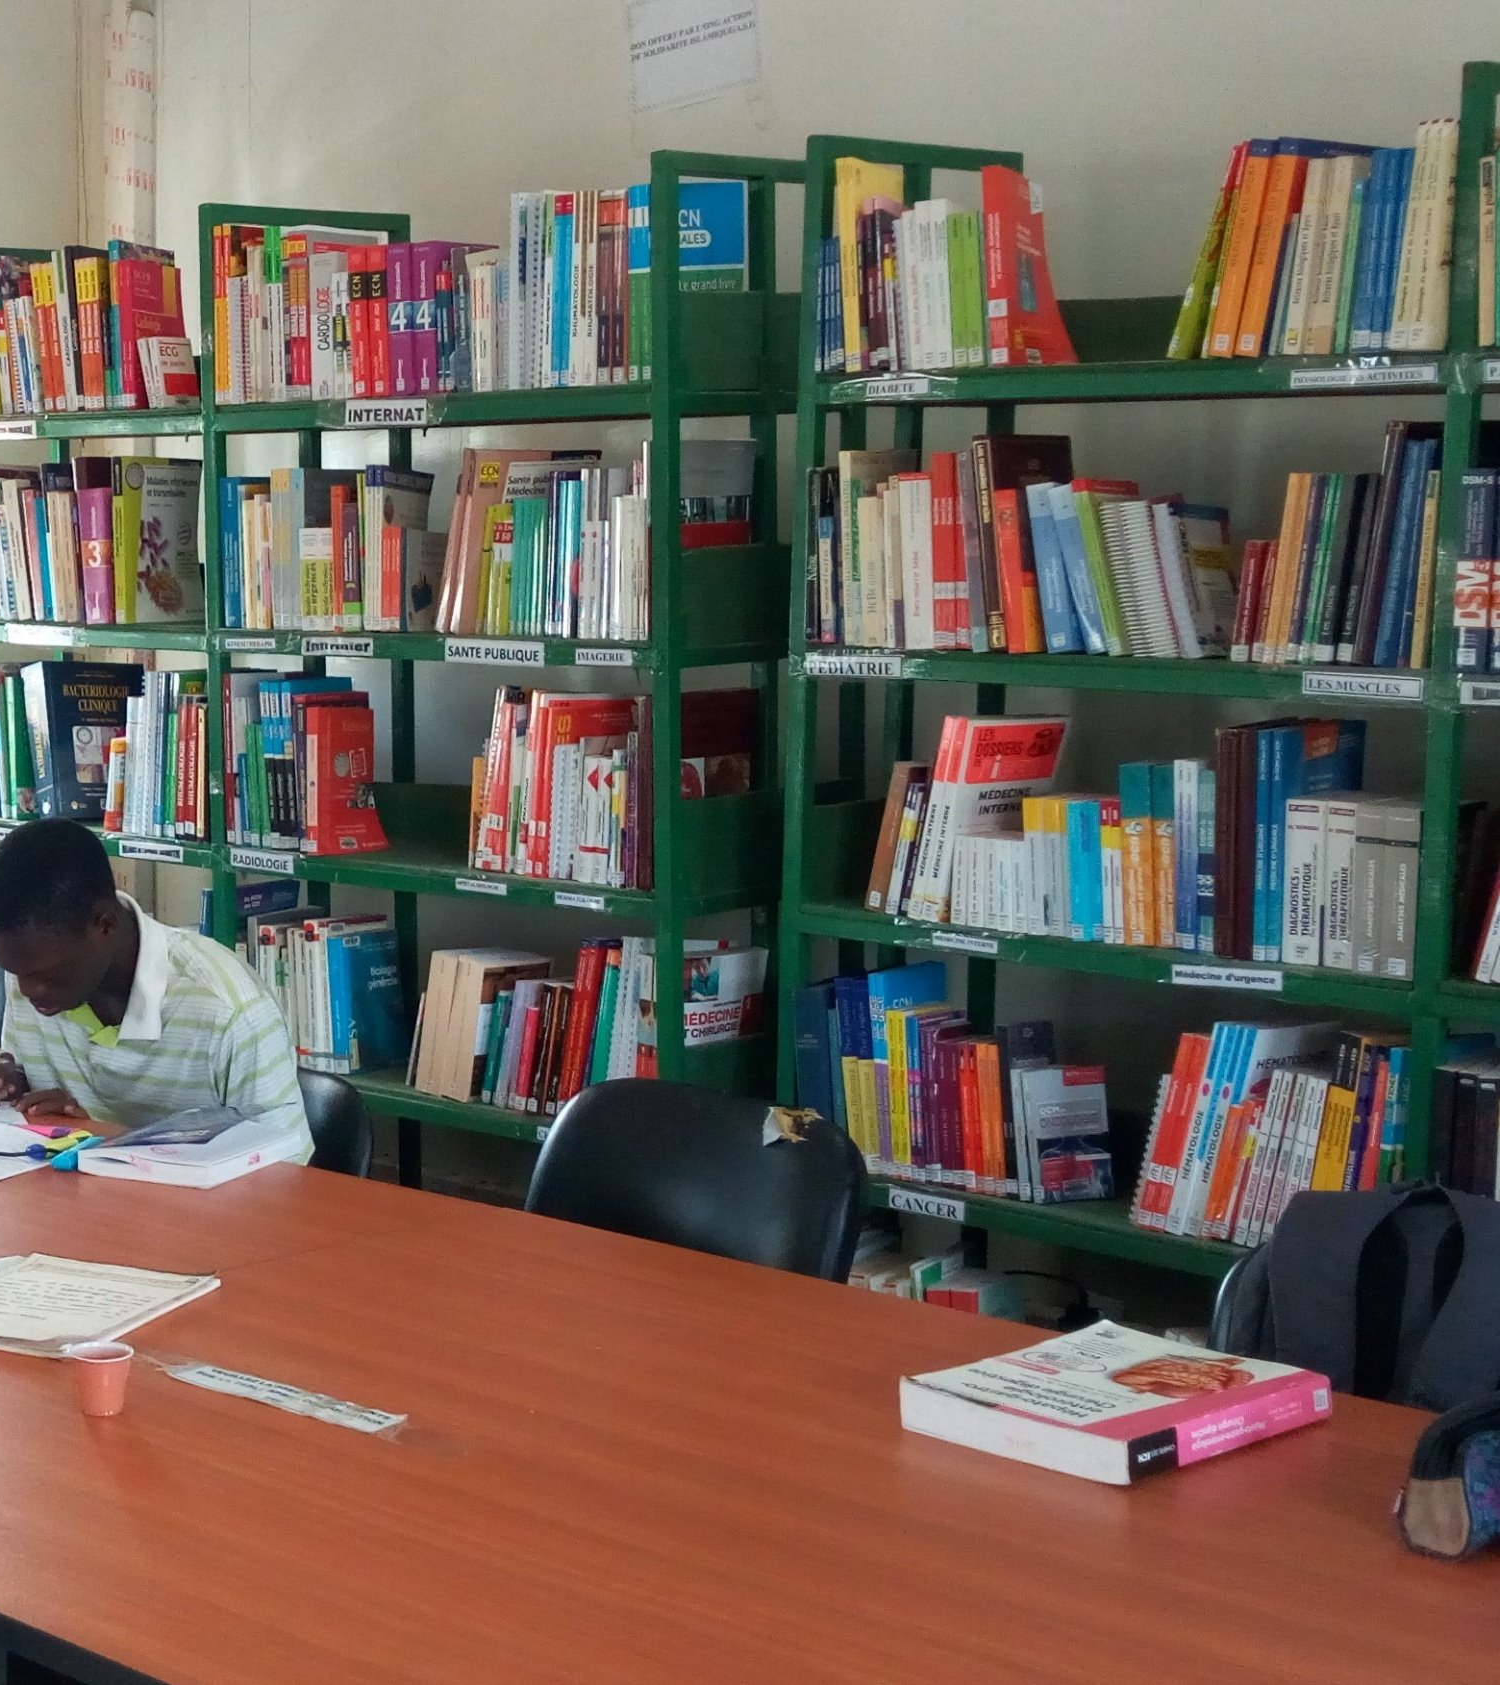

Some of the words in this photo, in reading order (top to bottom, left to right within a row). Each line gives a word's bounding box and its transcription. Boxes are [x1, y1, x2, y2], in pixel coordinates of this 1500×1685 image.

[679, 209, 701, 227] CN
[679, 234, 707, 246] ALES
[372, 274, 380, 296] ECN
[691, 279, 714, 292] grand
[716, 279, 736, 290] livre
[390, 305, 406, 331] 4
[416, 303, 431, 330] 4
[159, 346, 179, 357] ECG
[868, 382, 915, 396] DIABETE
[348, 408, 424, 422] INTERNAT
[481, 466, 499, 476] ECN
[86, 541, 101, 567] 3
[309, 563, 318, 604] urgences
[448, 646, 481, 659] SANTE
[485, 648, 539, 662] PUBLIQUE
[577, 652, 625, 662] IMAGERIE
[808, 662, 893, 675] PEDIATRIE
[1308, 678, 1333, 689] LES
[1336, 679, 1400, 693] MUSCLES
[78, 699, 119, 713] CLINIQUE
[926, 804, 937, 835] INTERNE
[939, 805, 950, 837] INTERNE
[233, 854, 288, 870] RADIOLOGIE
[1289, 876, 1299, 935] DIAGNOSTICS
[1300, 863, 1312, 935] THÉRAPEUTIQUE
[1330, 880, 1339, 939] DIAGNOSTICS
[1181, 1111, 1204, 1180] HÉMATOLOGIE
[1201, 1114, 1224, 1183] HÉMATOLOGIE
[892, 1194, 957, 1219] CANCER
